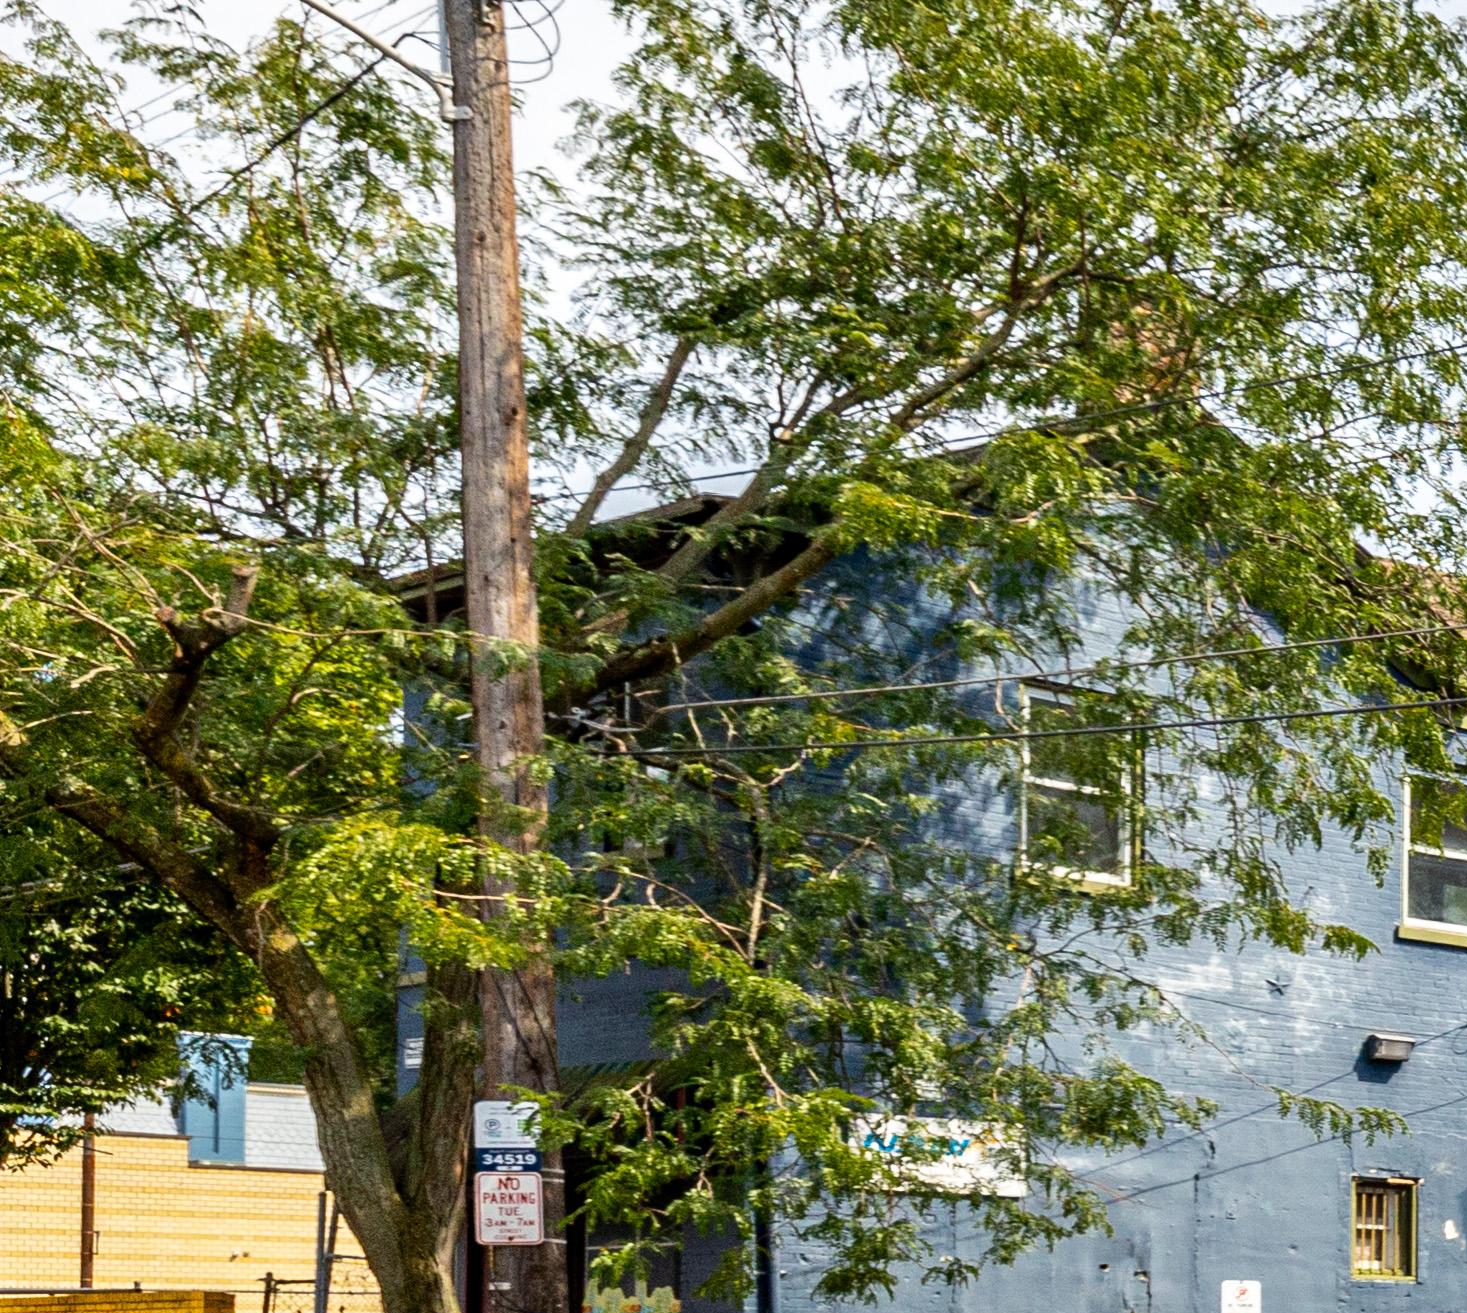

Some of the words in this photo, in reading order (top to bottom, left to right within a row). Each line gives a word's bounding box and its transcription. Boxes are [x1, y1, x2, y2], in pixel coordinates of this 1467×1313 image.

[481, 1153, 537, 1165] 34519
[497, 1177, 520, 1191] NO
[482, 1192, 536, 1205] PARKING
